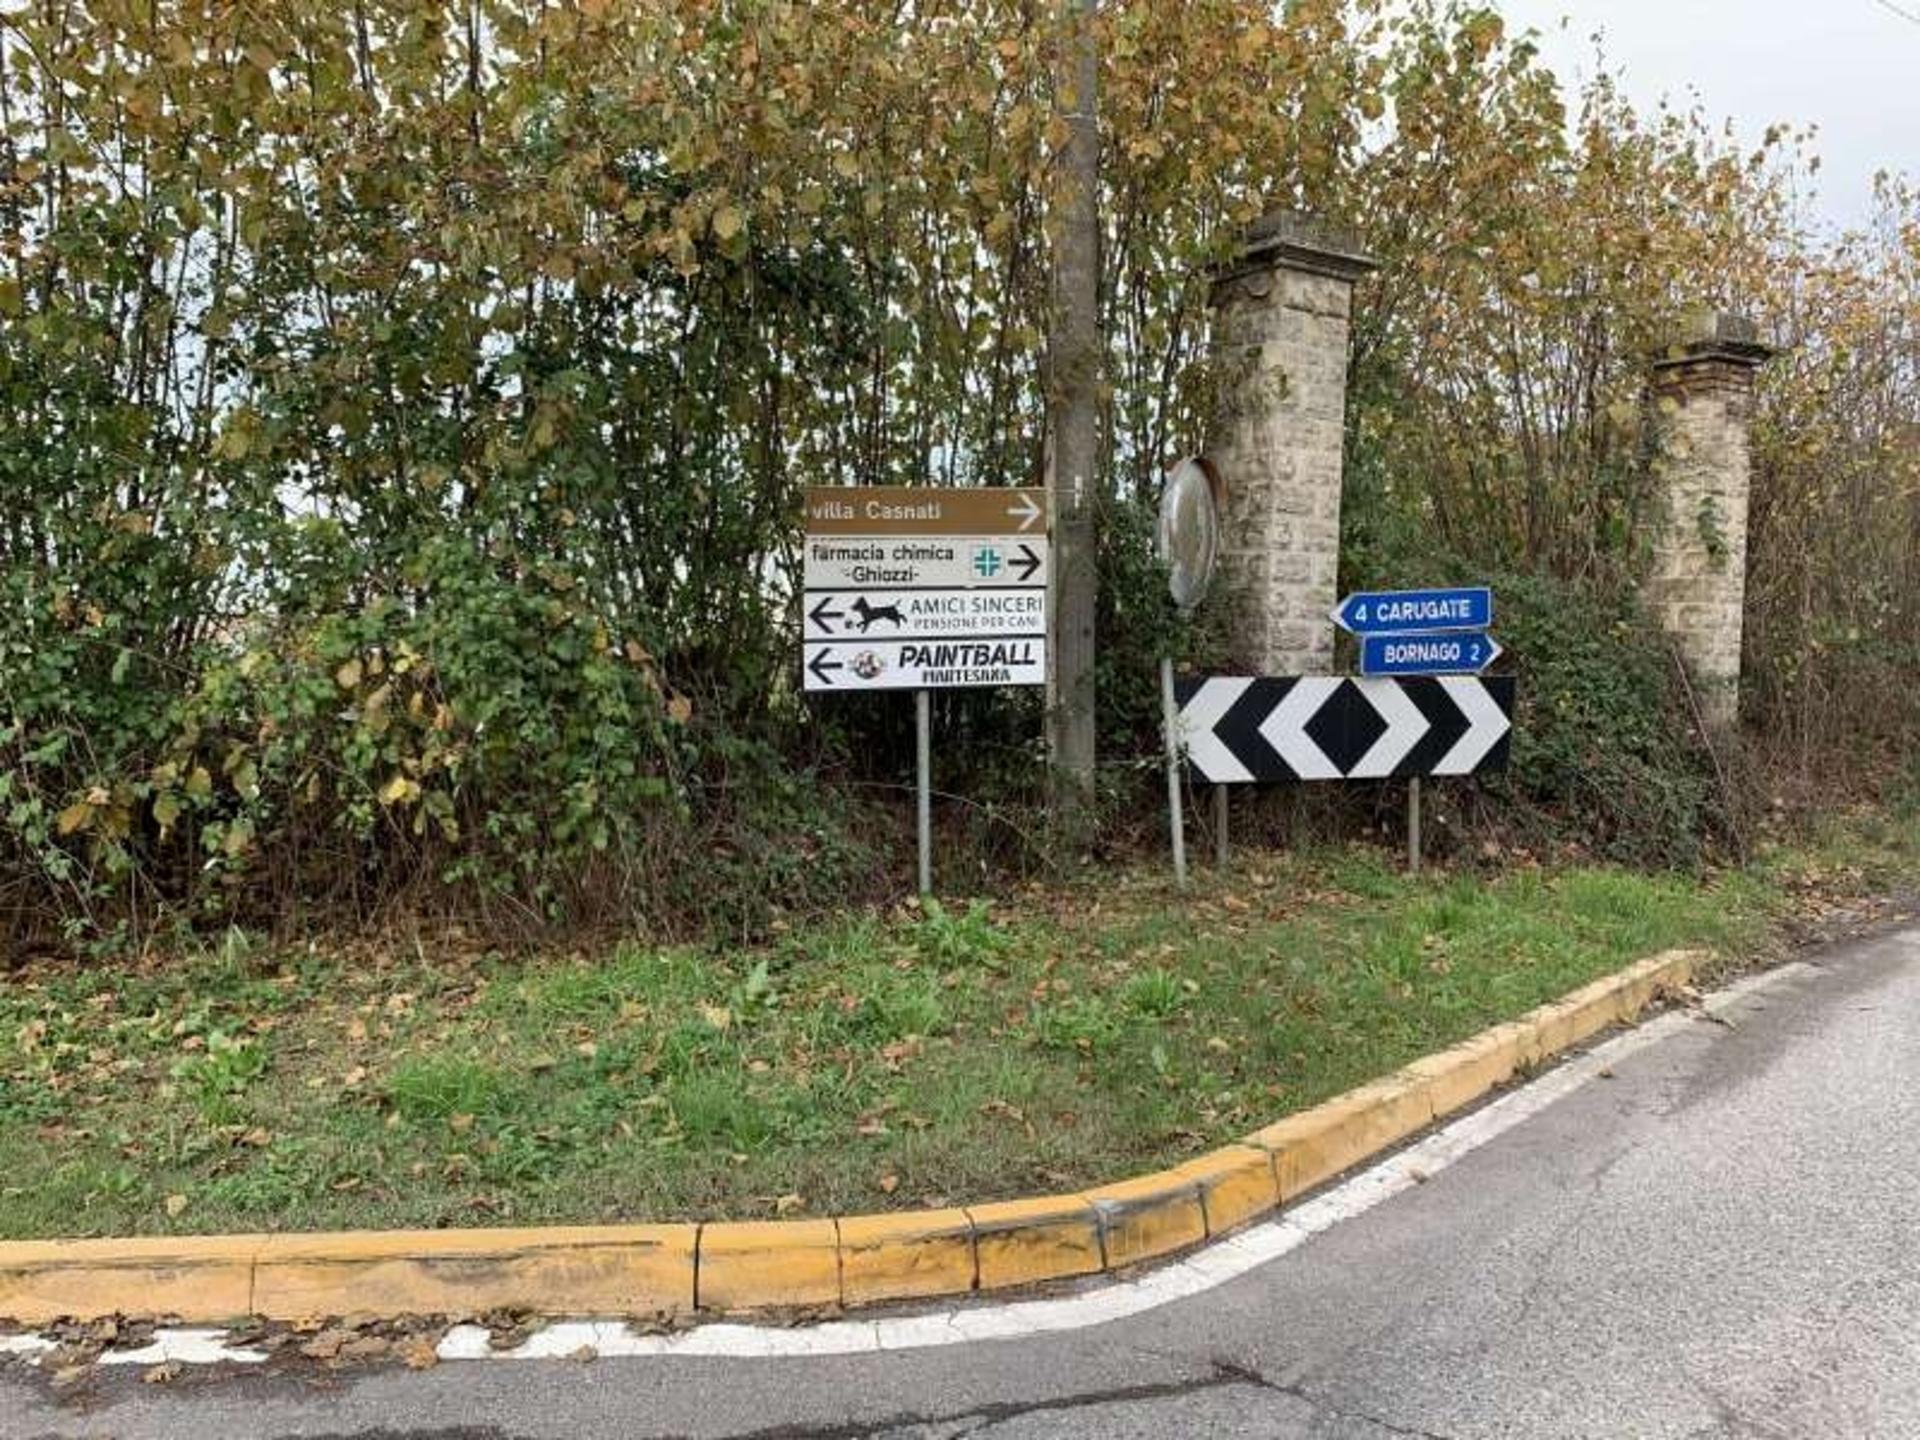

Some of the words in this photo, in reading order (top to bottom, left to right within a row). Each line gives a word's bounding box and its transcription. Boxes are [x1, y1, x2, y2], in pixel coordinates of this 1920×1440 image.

[812, 501, 854, 520] villa
[866, 501, 942, 520] Casnati
[812, 544, 884, 561] farmacia
[892, 544, 954, 561] chimica
[911, 597, 966, 614] AMICI
[971, 596, 1043, 613] SINCERI
[1355, 604, 1367, 622] 4
[1376, 599, 1472, 622] CARUGATE
[914, 616, 979, 629] PENSIONE
[981, 616, 1004, 628] PER
[899, 642, 1036, 668] PAINTBALL
[1384, 642, 1460, 663] BORNAGO
[1469, 644, 1480, 661] 2
